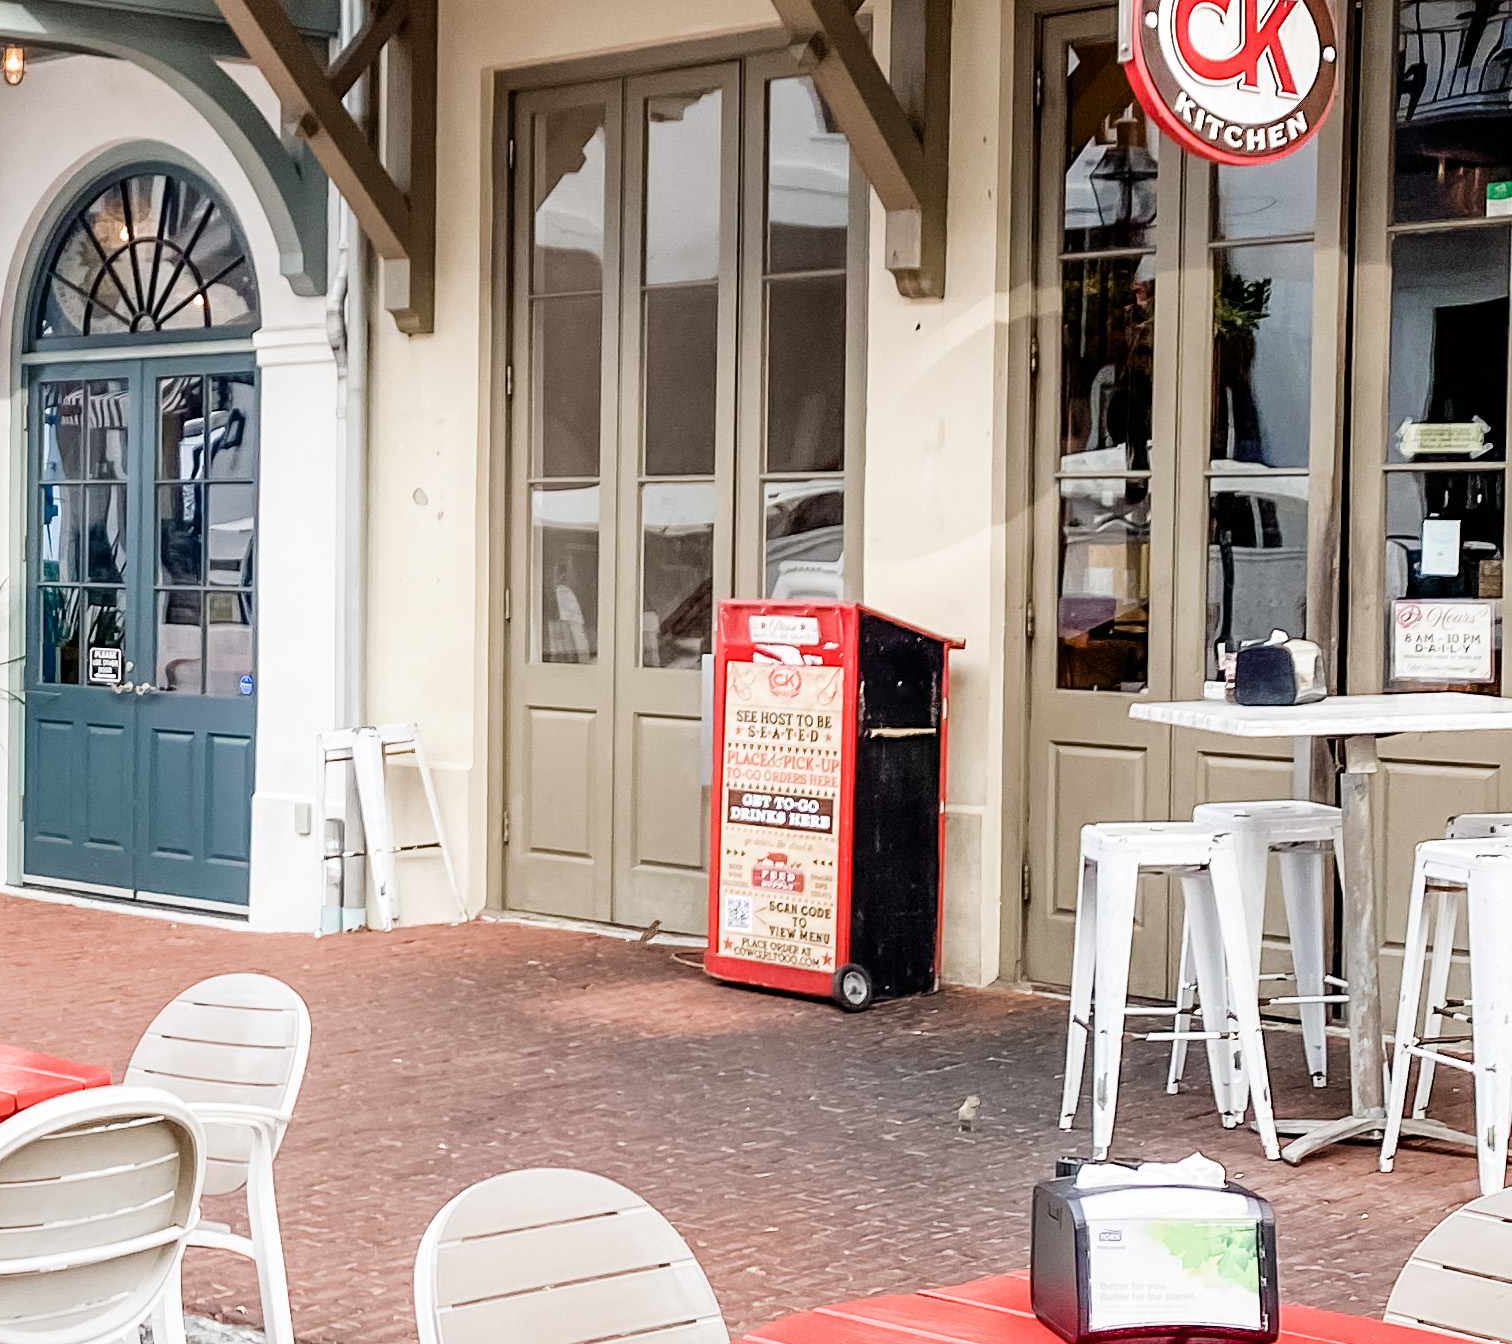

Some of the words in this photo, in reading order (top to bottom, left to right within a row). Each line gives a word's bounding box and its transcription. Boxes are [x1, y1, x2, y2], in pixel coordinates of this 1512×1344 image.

[1174, 91, 1309, 152] KITCHEN
[1404, 633, 1412, 643] 8
[1416, 633, 1434, 643] AM
[1447, 633, 1459, 644] 10
[1463, 633, 1482, 644] PM
[736, 710, 758, 724] SEE
[760, 711, 794, 726] HOST
[796, 714, 814, 728] TO
[817, 715, 833, 729] BE
[727, 750, 768, 767] PLACE
[783, 755, 840, 773] PICK-UP
[727, 767, 762, 781] TO-GO
[764, 769, 807, 785] ORDERS
[809, 773, 838, 788] HERE
[741, 793, 772, 808] GET
[774, 796, 820, 813] TO-GO
[730, 806, 787, 825] DRINKS
[788, 812, 831, 830] HERE
[769, 900, 798, 914] SCAN
[800, 905, 832, 919] CODE
[792, 916, 807, 929] TO
[741, 937, 768, 950] PLACE
[769, 925, 796, 940] VIEW
[799, 930, 831, 944] MENU
[1100, 1282, 1128, 1291] Better
[1131, 1282, 1145, 1291] for
[1100, 1292, 1129, 1302] Better
[1131, 1292, 1145, 1301] for
[1147, 1292, 1164, 1301] the
